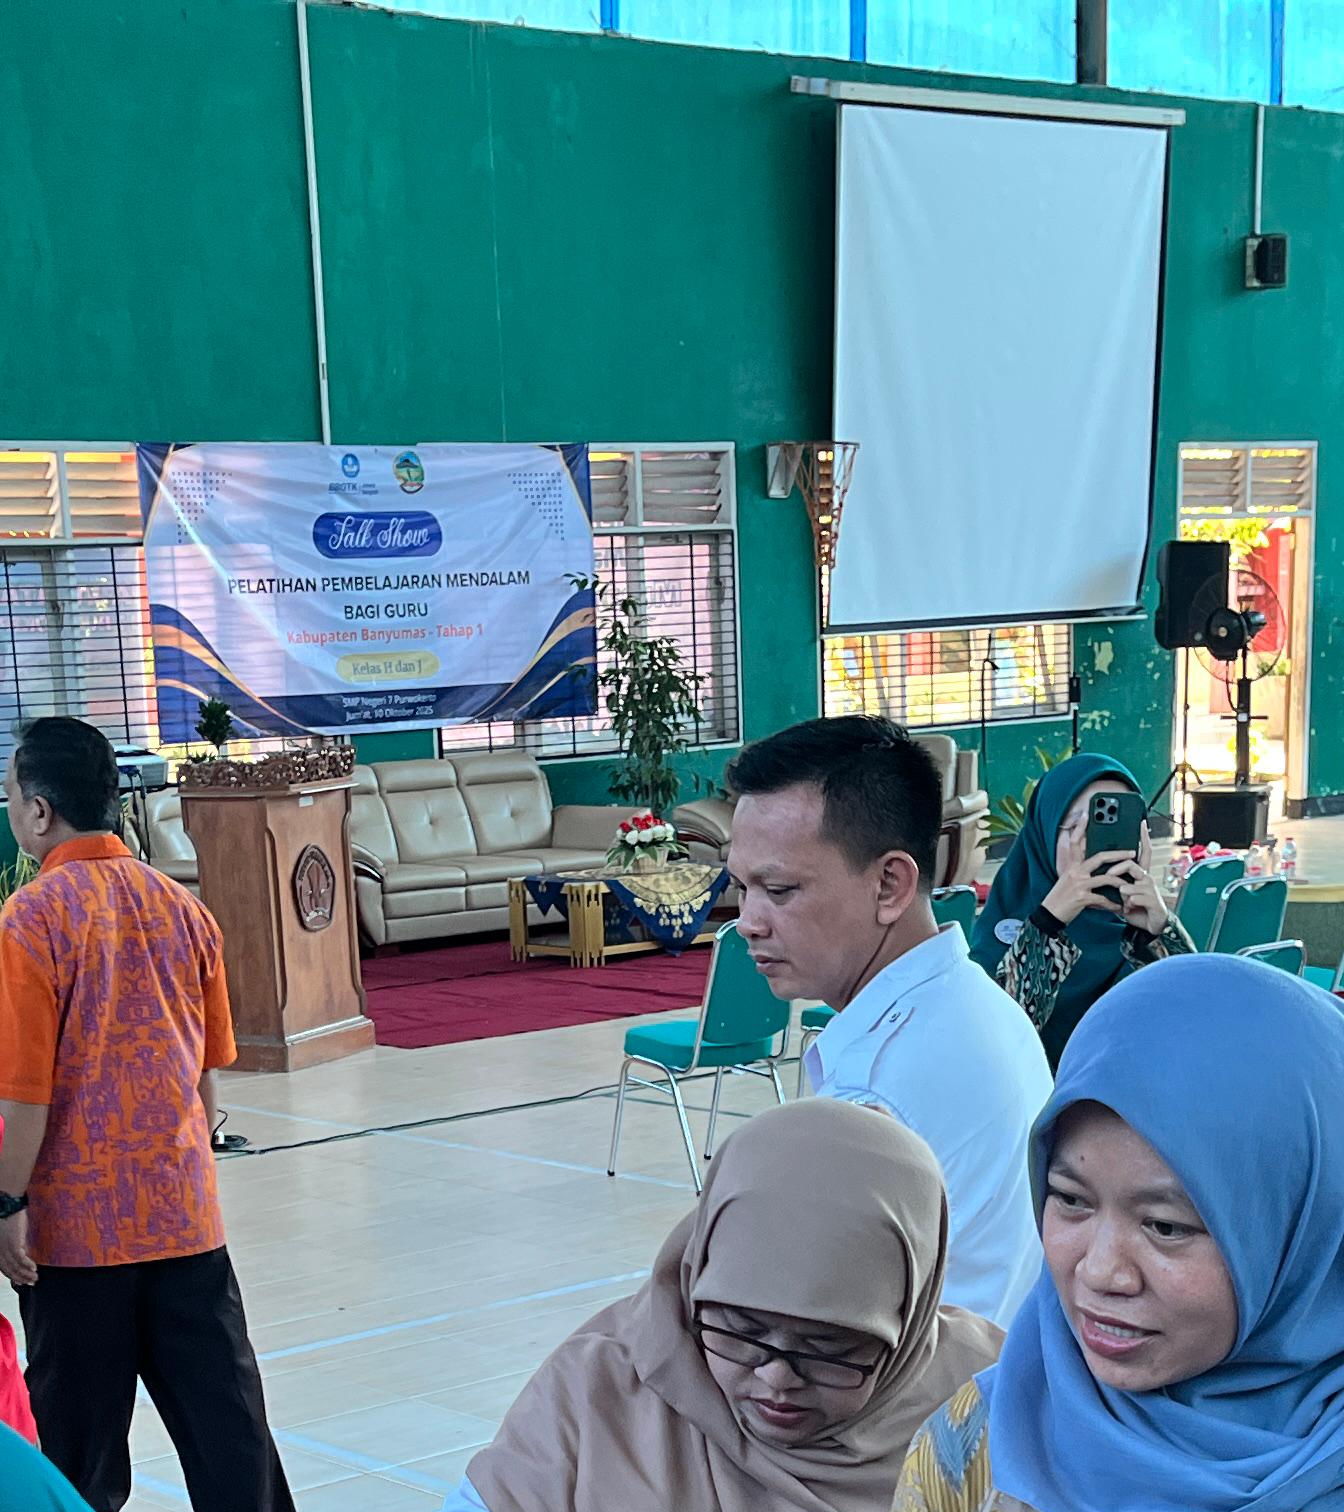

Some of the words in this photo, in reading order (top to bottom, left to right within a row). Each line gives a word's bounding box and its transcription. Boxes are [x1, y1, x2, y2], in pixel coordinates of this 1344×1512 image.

[328, 515, 374, 550] Talk
[376, 517, 430, 549] Show
[228, 577, 317, 594] PELATIHAN
[321, 573, 441, 592] PEMBELAJARAN
[446, 570, 530, 588] MENDALAM
[344, 603, 380, 620] BAGI
[384, 602, 428, 618] GURU
[287, 630, 357, 647] Kabupaten
[361, 627, 426, 644] Banyumas
[436, 623, 473, 640] Tahap
[476, 623, 484, 636] 1
[352, 661, 382, 676] Kelas
[384, 661, 394, 674] H
[395, 660, 416, 674] dan
[342, 695, 362, 708] SMP
